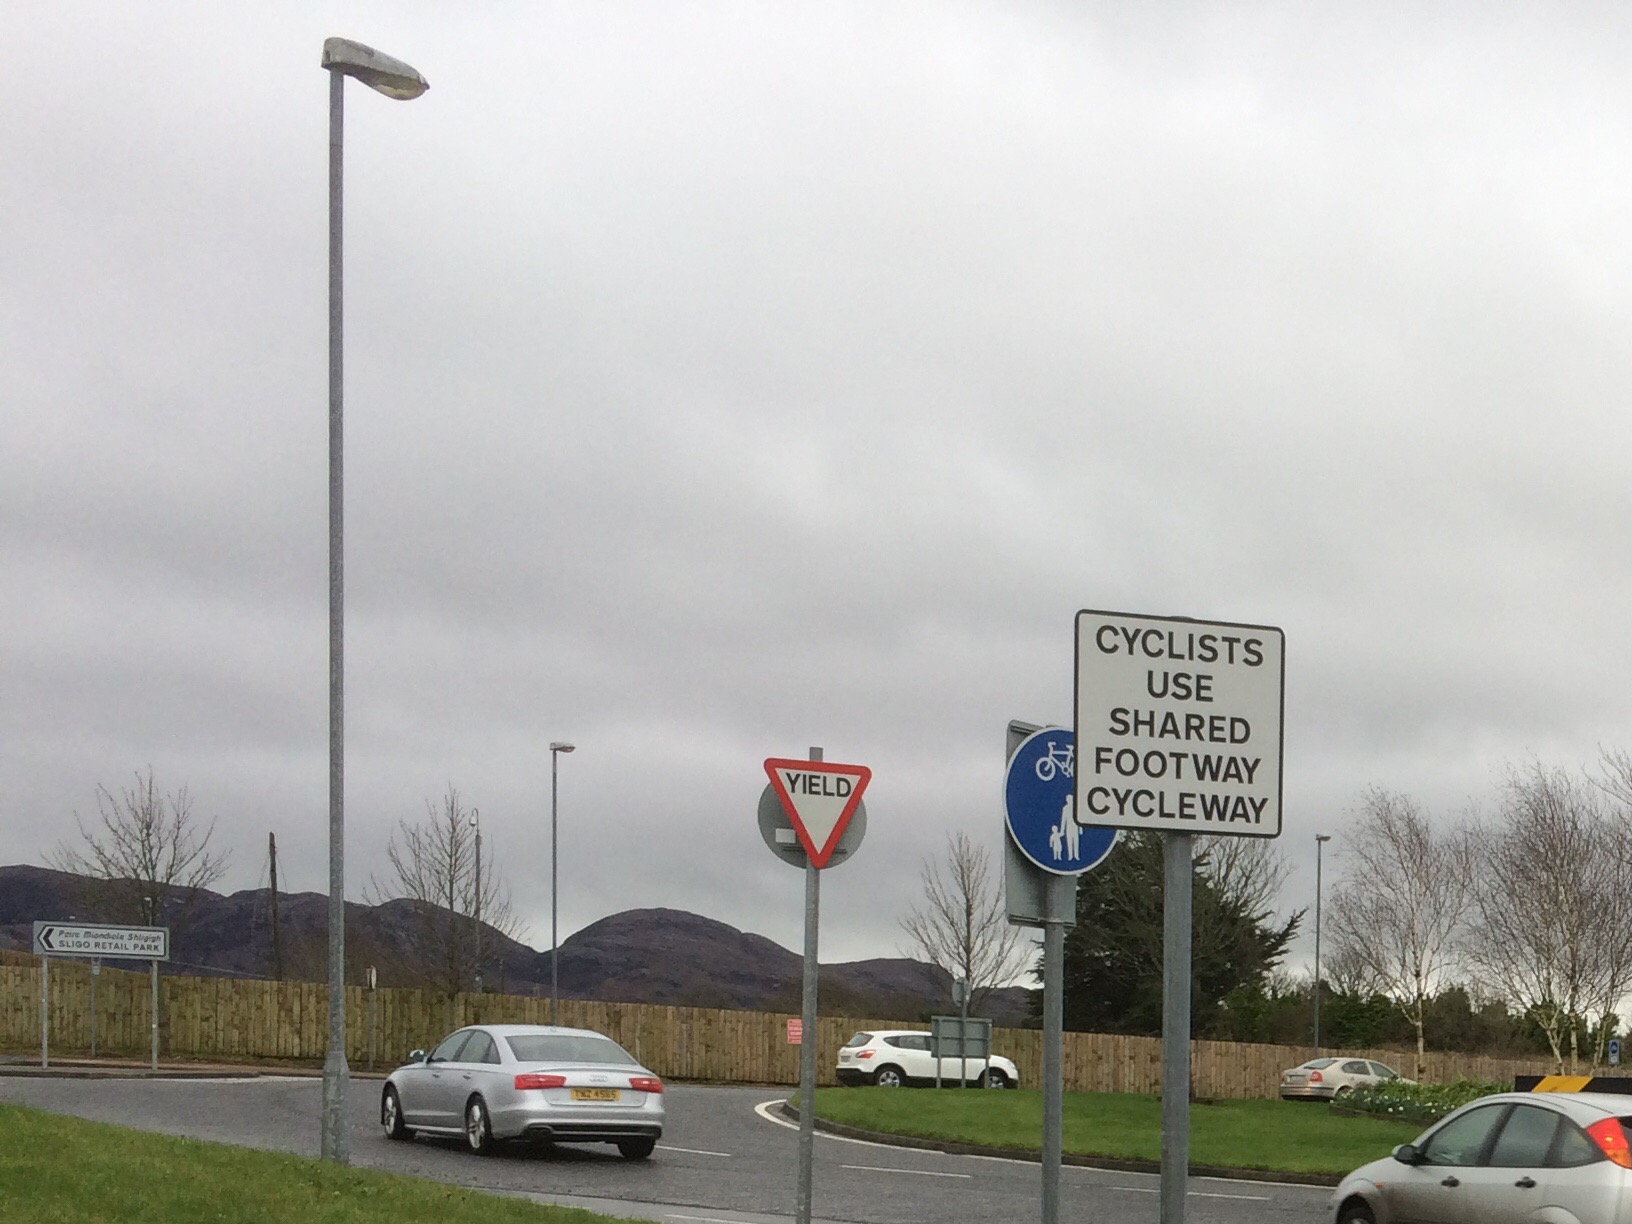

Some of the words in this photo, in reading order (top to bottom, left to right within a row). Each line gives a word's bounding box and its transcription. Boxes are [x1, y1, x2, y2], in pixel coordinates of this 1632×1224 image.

[1096, 625, 1264, 667] CYCLISTS
[1147, 670, 1214, 702] USE
[1108, 707, 1251, 745] SHARED
[1095, 746, 1261, 785] FOOTWAY
[785, 772, 851, 798] YIELD
[1086, 786, 1269, 824] CYCLEWAY
[59, 940, 90, 949] SLIGO
[94, 941, 129, 950] RETAIL
[133, 942, 160, 952] PARK
